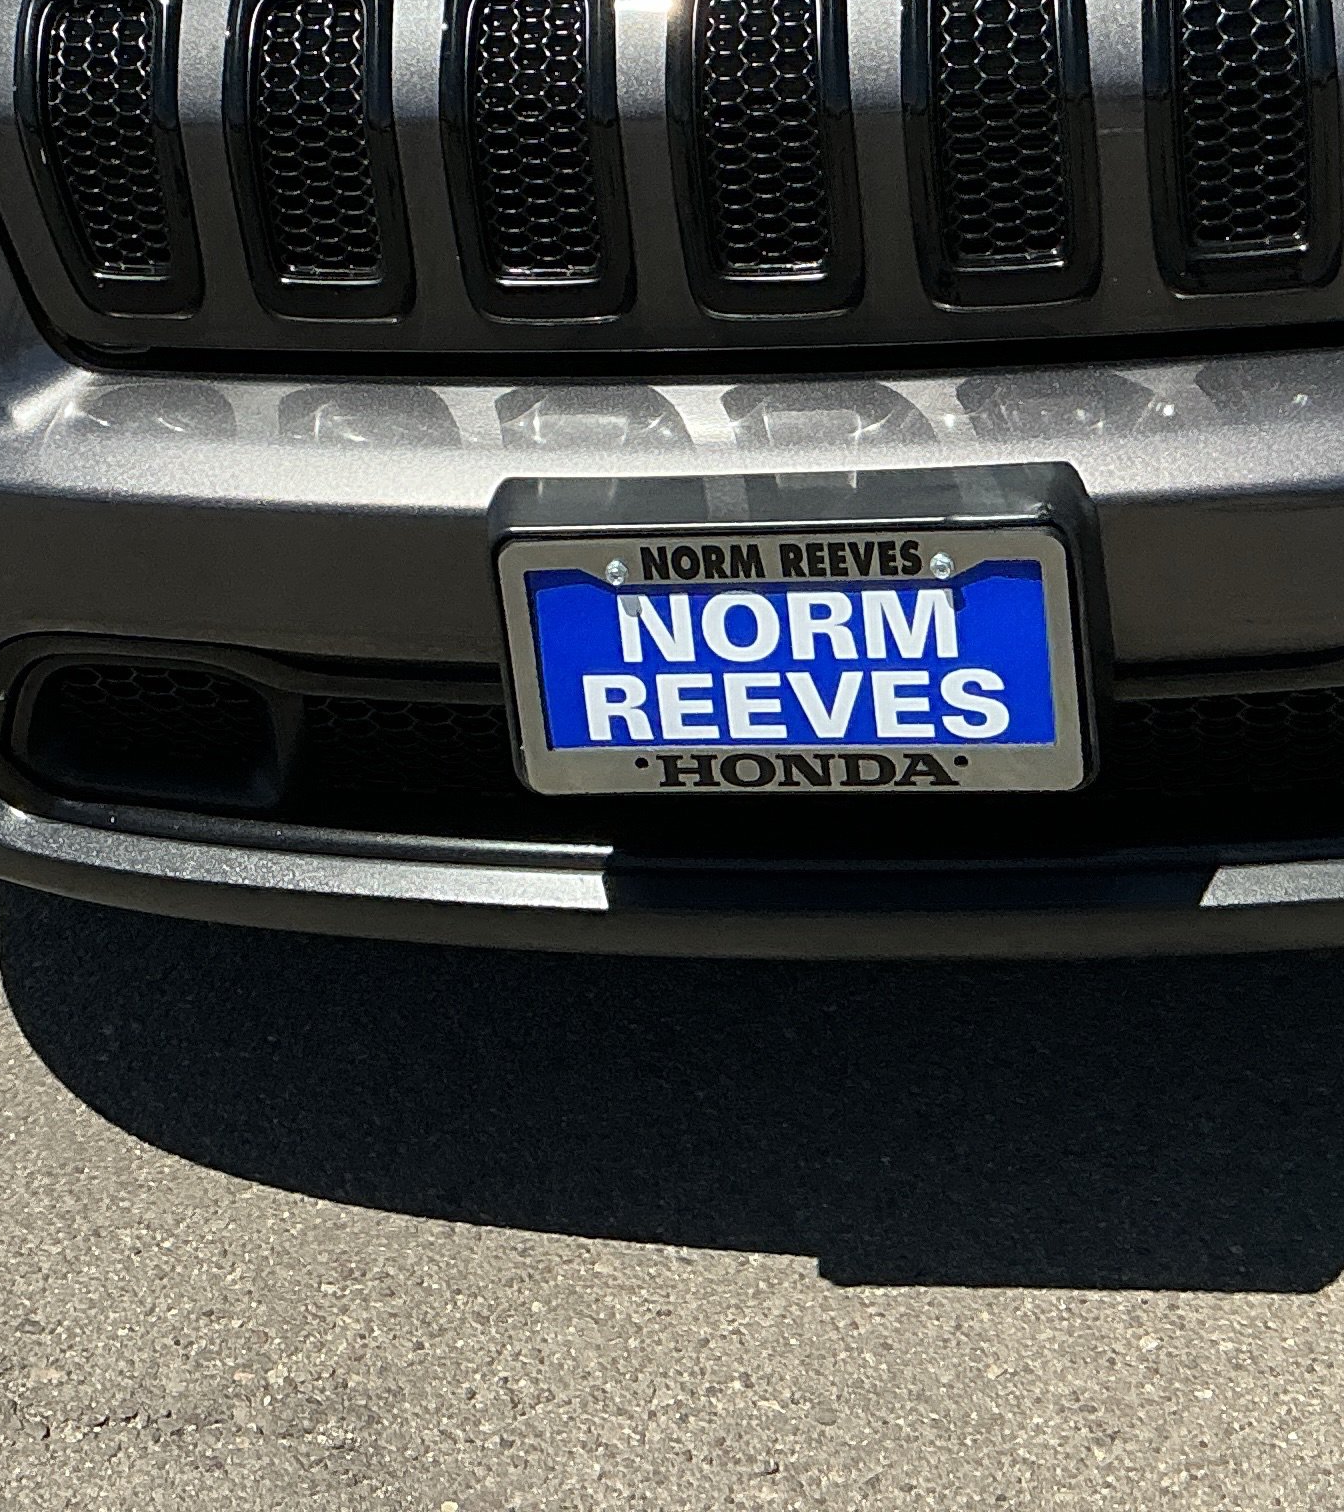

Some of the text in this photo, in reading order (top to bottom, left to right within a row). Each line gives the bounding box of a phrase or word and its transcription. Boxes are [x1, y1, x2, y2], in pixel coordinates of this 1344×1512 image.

[639, 539, 923, 581] NORM REEVES
[616, 587, 960, 664] NORM
[581, 666, 1010, 742] REEVES
[658, 752, 961, 788] HONDA
